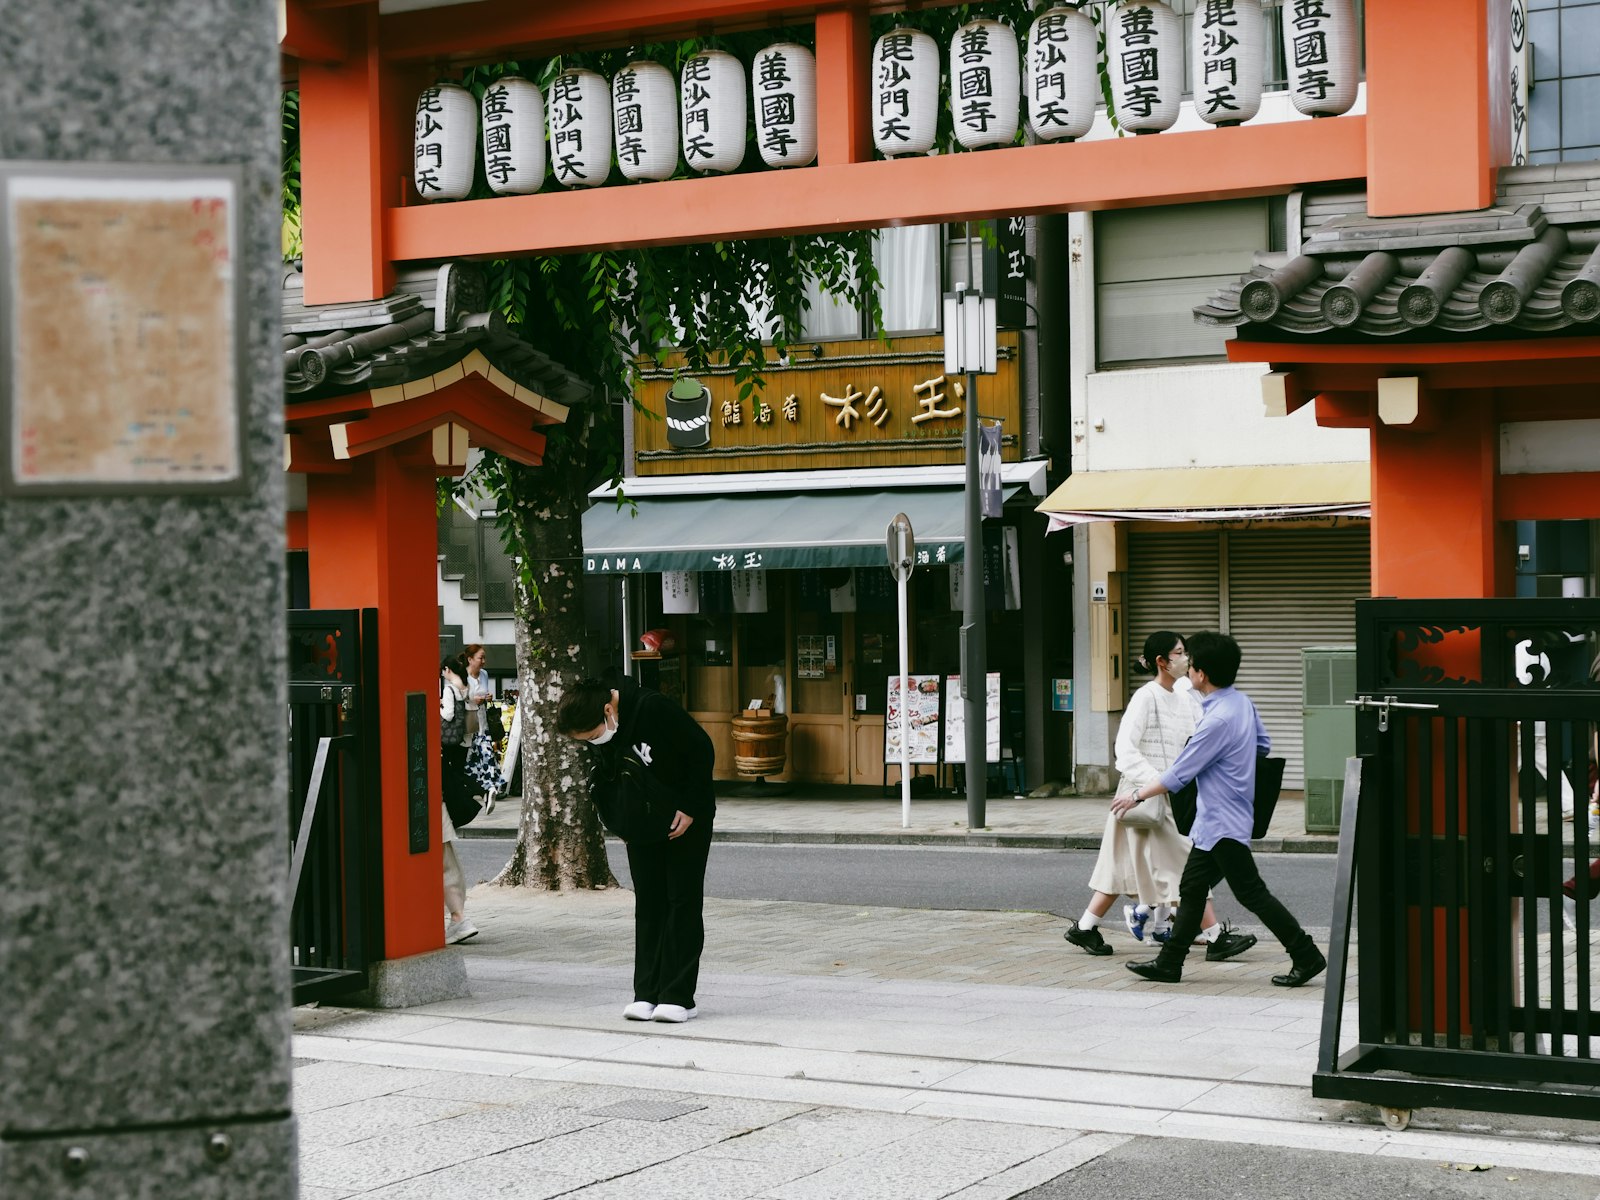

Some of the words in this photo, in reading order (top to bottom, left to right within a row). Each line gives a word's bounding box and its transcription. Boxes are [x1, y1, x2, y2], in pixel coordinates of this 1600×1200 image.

[879, 35, 914, 142] 毘沙門天
[959, 25, 996, 133] 善國寺
[1034, 14, 1070, 127] 毘沙門天
[1121, 6, 1162, 117] 善國寺
[1202, 0, 1240, 113] 毘沙門天
[1290, 0, 1335, 100] 善國寺
[416, 88, 443, 194] 毘沙門天
[484, 85, 517, 184] 善國寺
[552, 74, 588, 181] 毘沙門天
[615, 69, 647, 166] 善國寺
[683, 56, 714, 160] 毘沙門天
[759, 51, 797, 157] 善國寺
[1008, 216, 1025, 278] 杉玉
[820, 375, 964, 429] 杉玉
[712, 551, 762, 570] 杉玉
